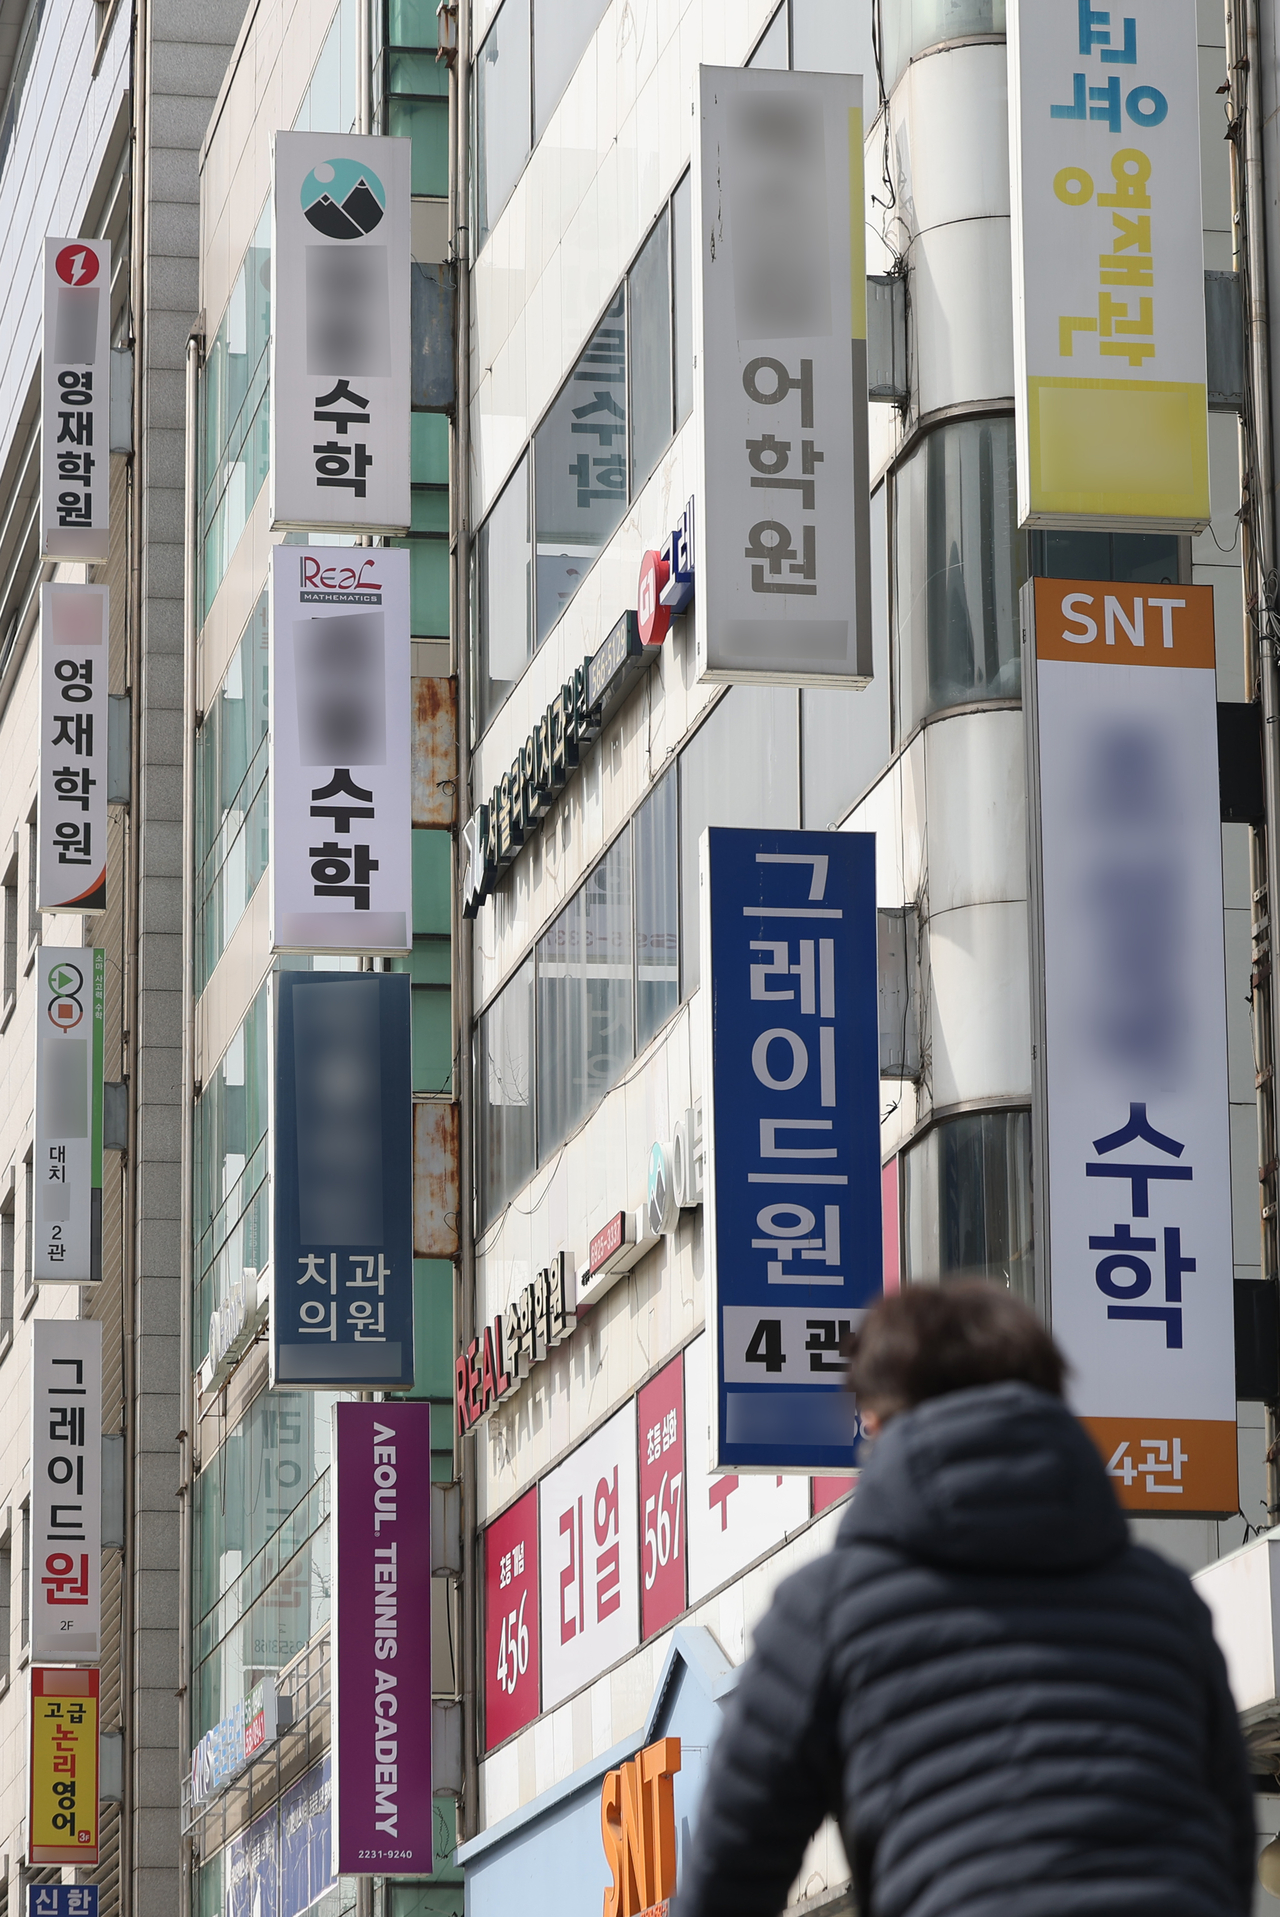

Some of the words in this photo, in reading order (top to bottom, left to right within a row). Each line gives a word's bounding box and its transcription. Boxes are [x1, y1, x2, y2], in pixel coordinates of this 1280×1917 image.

[1053, 148, 1156, 366] 영재관
[57, 370, 96, 528] 영재학원
[312, 378, 373, 498] 수학
[742, 356, 824, 596] 어학원
[304, 594, 378, 602] MATHEMATICS
[1061, 592, 1186, 650] SNT
[592, 623, 626, 698] 566-5129
[51, 658, 97, 866] 영재학원
[309, 768, 379, 911] 수학
[742, 853, 849, 1286] 그레이드원
[48, 1145, 66, 1184] 대치
[296, 1252, 390, 1296] 치과
[1085, 1102, 1197, 1350] 수학
[298, 1300, 387, 1342] 의원
[456, 1314, 511, 1437] REAL
[41, 1358, 89, 1606] 그레이드원
[647, 1421, 661, 1466] 초등
[663, 1408, 677, 1453] 심화
[499, 1551, 511, 1590] 초등
[512, 1540, 524, 1578] 개념
[559, 1462, 621, 1647] 리얼
[645, 1470, 682, 1591] 567
[60, 1620, 74, 1631] 2F
[374, 1542, 398, 1661] TENNIS
[497, 1589, 529, 1695] 456
[43, 1702, 87, 1724] 고급
[374, 1669, 399, 1839] ACADEMY
[51, 1724, 79, 1837] 논리영어
[79, 1832, 90, 1842] 3F
[601, 1737, 682, 1917] SNT
[35, 1888, 92, 1916] 신한
[358, 1849, 413, 1861] 2231-9240
